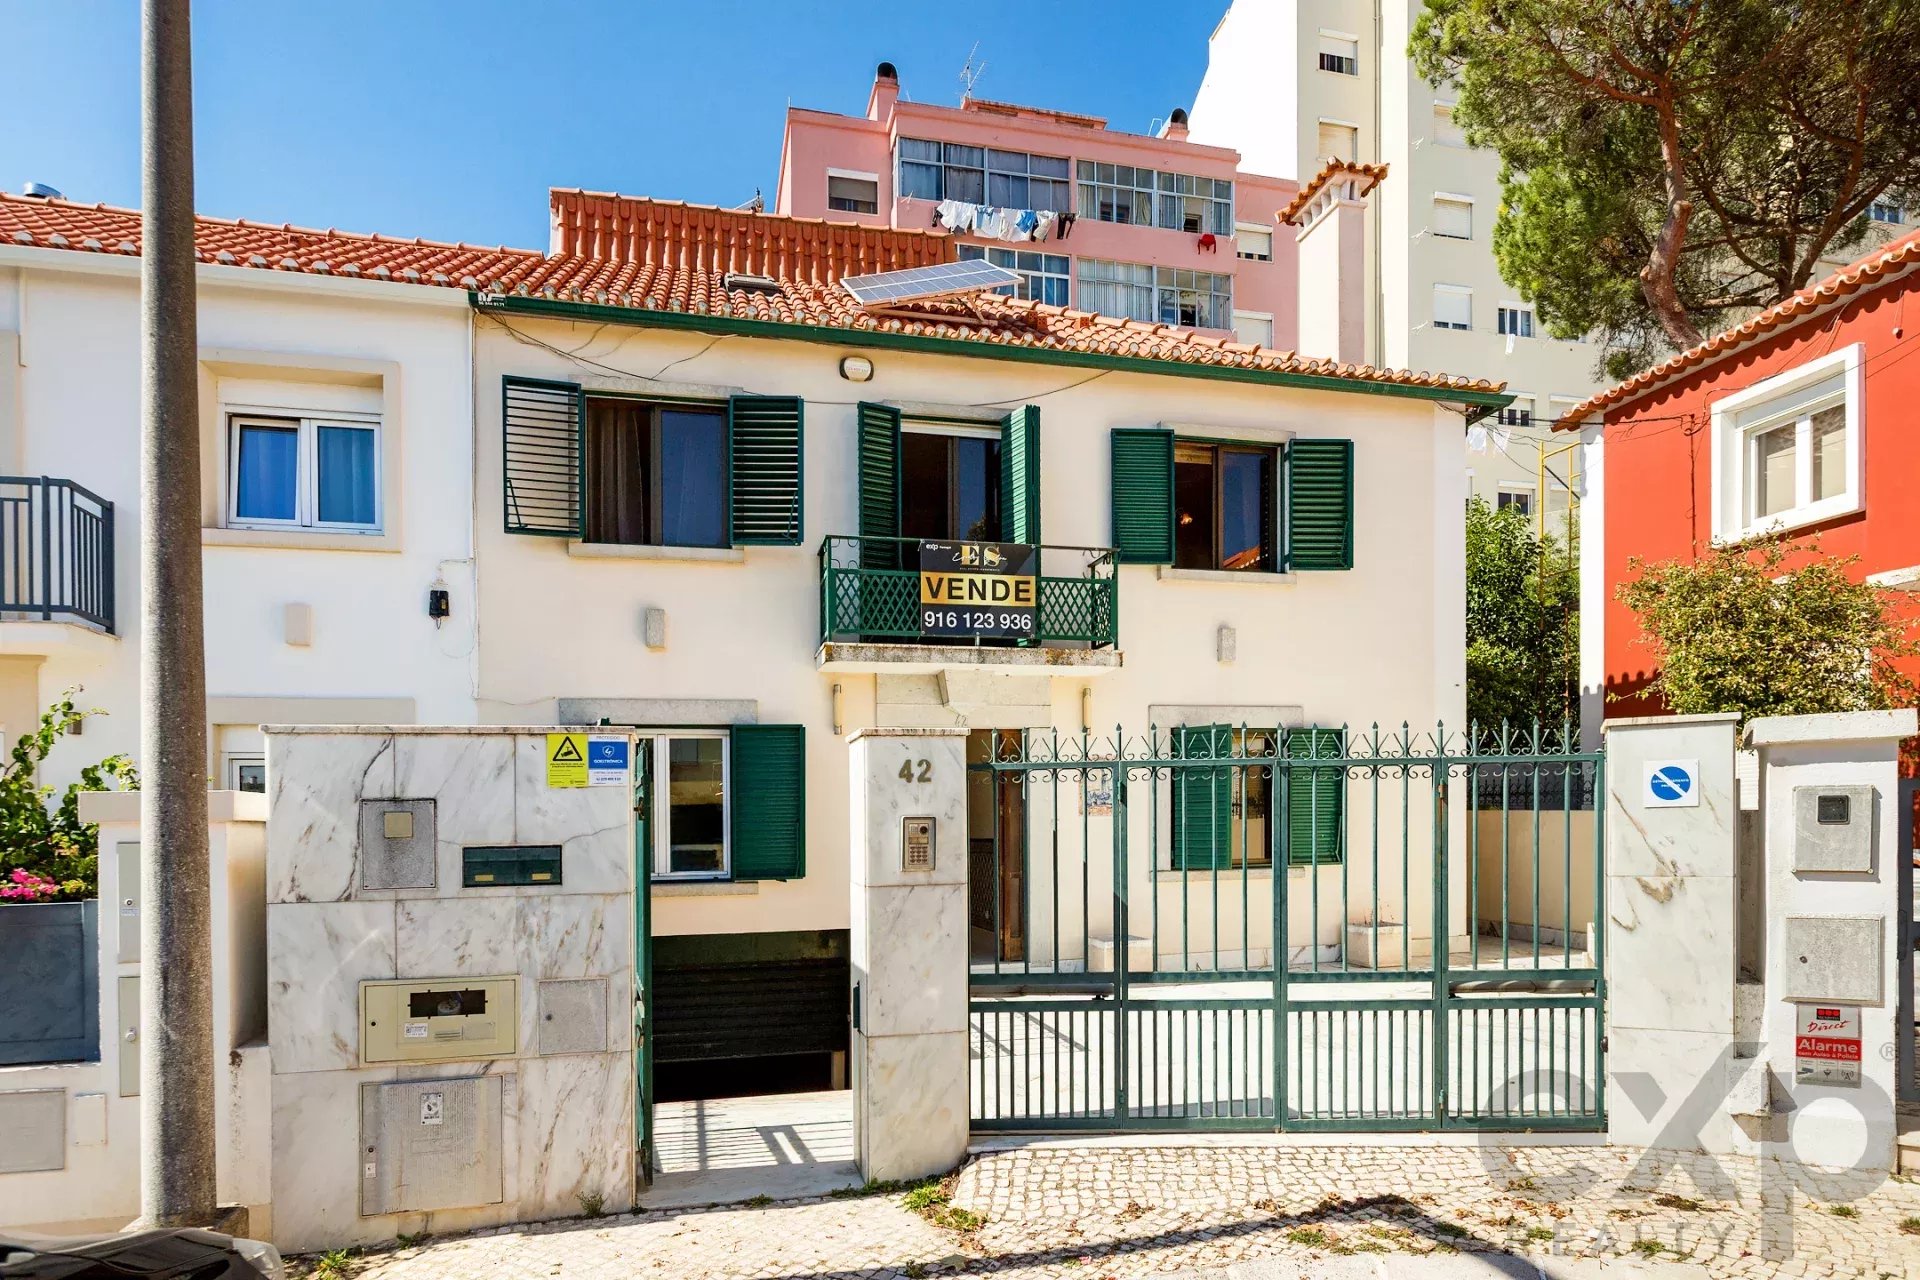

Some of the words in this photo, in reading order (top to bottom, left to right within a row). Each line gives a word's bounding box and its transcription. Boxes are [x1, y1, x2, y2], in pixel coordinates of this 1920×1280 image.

[925, 577, 1031, 602] VENDE
[924, 611, 957, 628] 916
[962, 612, 995, 628] 123
[1000, 614, 1032, 630] 936
[898, 759, 932, 783] 42
[1807, 1020, 1853, 1033] Direct
[1798, 1039, 1858, 1053] Alarme
